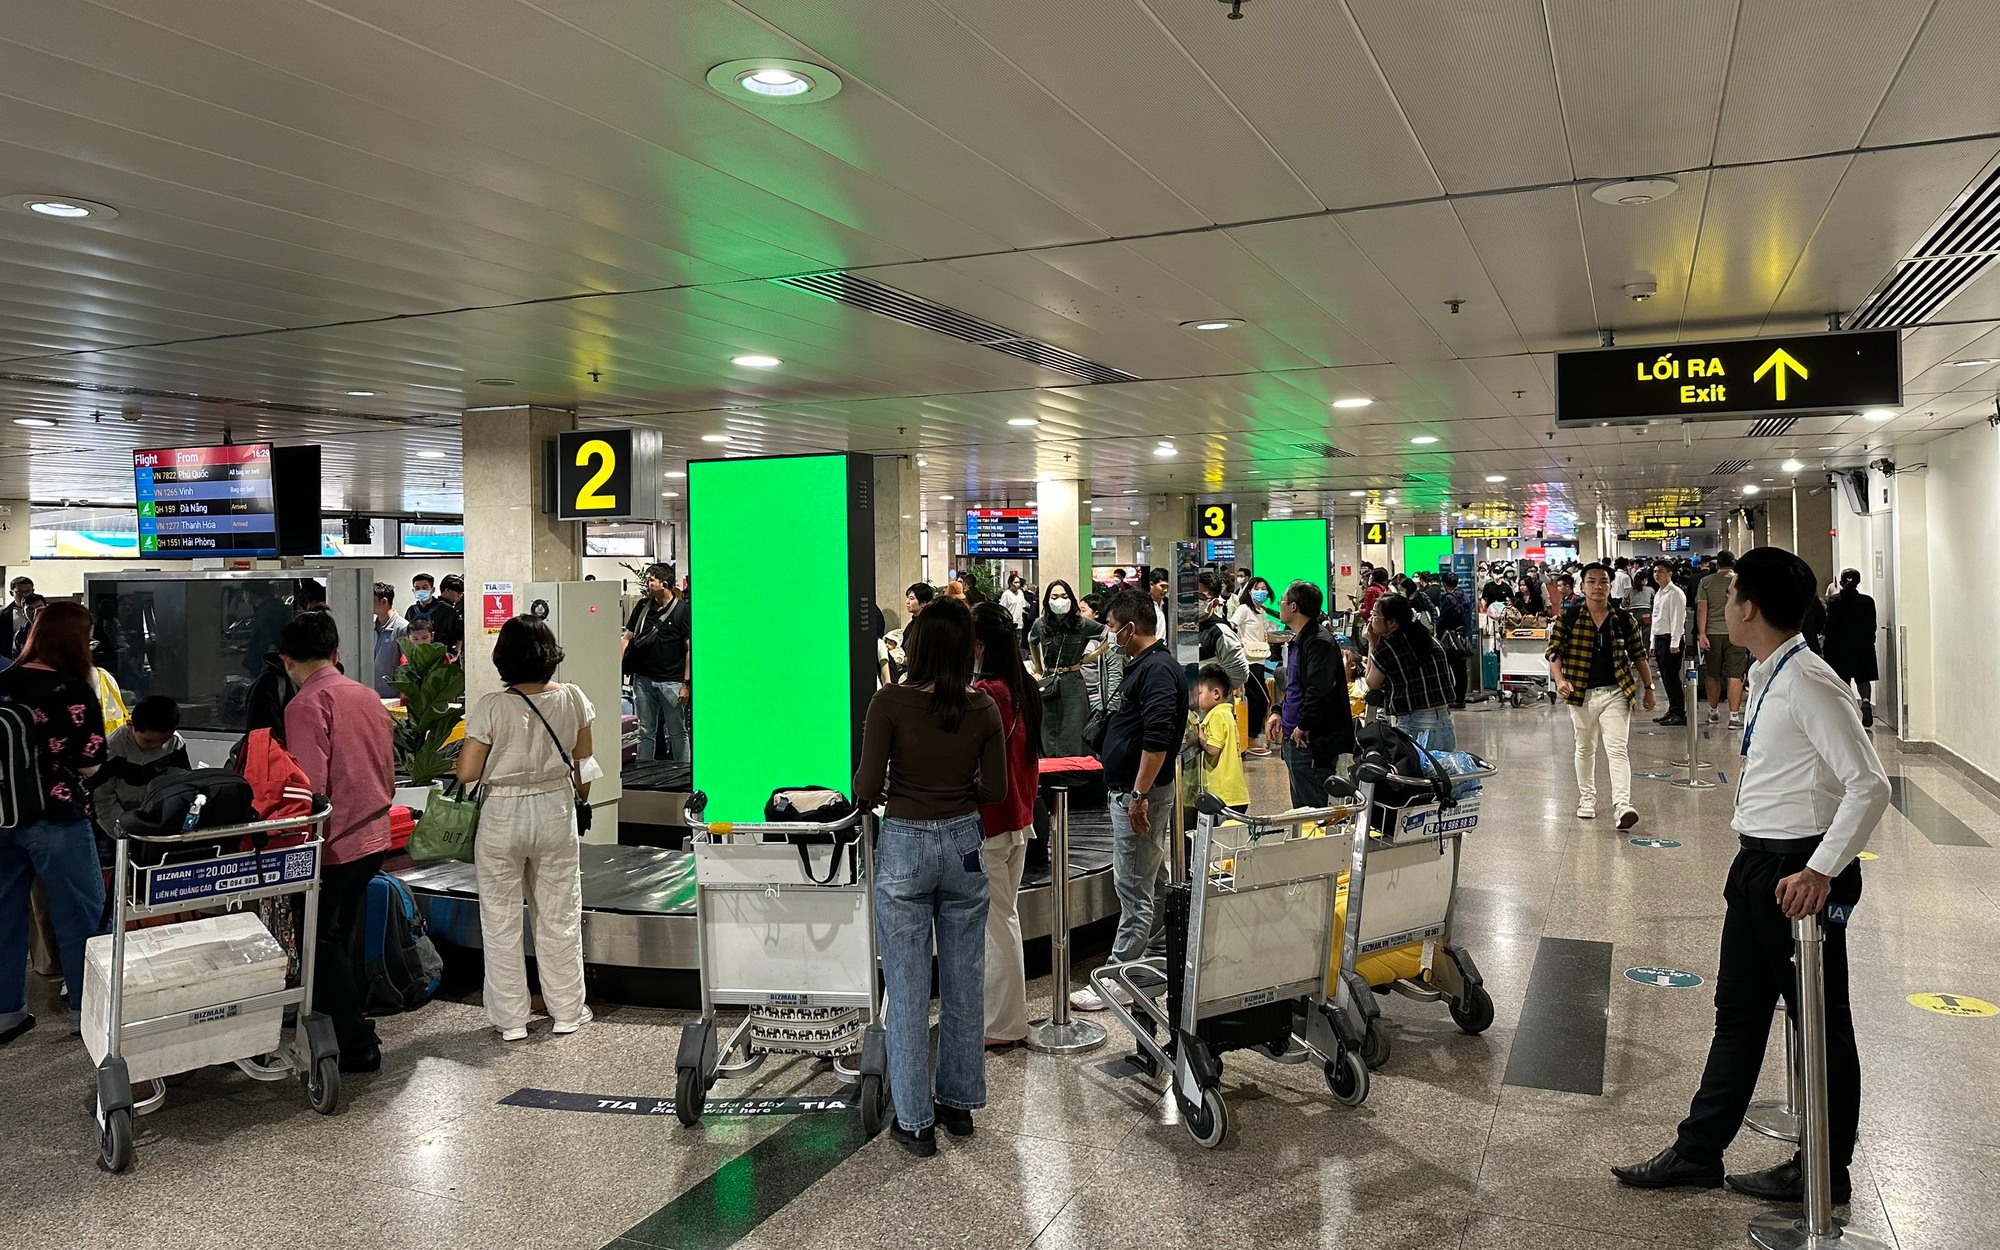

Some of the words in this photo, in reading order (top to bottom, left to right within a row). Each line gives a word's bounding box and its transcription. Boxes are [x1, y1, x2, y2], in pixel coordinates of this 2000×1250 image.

[1637, 353, 1680, 381] LỐI
[1687, 357, 1726, 378] RA
[1680, 384, 1727, 404] Exit
[135, 453, 158, 467] Flight
[177, 452, 199, 463] From
[153, 472, 162, 480] VN
[162, 471, 177, 480] 7822
[178, 470, 191, 479] Phú
[191, 469, 209, 479] Quốc
[575, 439, 616, 510] 2
[178, 486, 194, 496] Vinh
[164, 505, 176, 514] 159
[179, 503, 189, 513] Đà
[165, 521, 180, 530] 1277
[181, 520, 202, 530] Thanh
[202, 519, 217, 529] Hóa
[1204, 506, 1225, 537] 3
[1367, 524, 1383, 543] 4
[167, 538, 181, 547] 1551
[182, 536, 194, 547] Hải
[194, 536, 216, 548] Phòng
[1490, 539, 1499, 549] 5
[1510, 540, 1518, 549] 6
[1435, 817, 1475, 832] 04.986.98.98
[156, 869, 192, 882] BIZMAN
[205, 863, 238, 878] 20.000
[155, 890, 169, 899] LIÊN
[170, 888, 178, 897] HỆ
[179, 886, 199, 896] QUẢNG
[200, 883, 212, 892] CÁO
[1828, 905, 1845, 920] IA
[194, 1008, 225, 1019] BIZMAN
[597, 1099, 638, 1110] TIA
[798, 1100, 847, 1110] TIA
